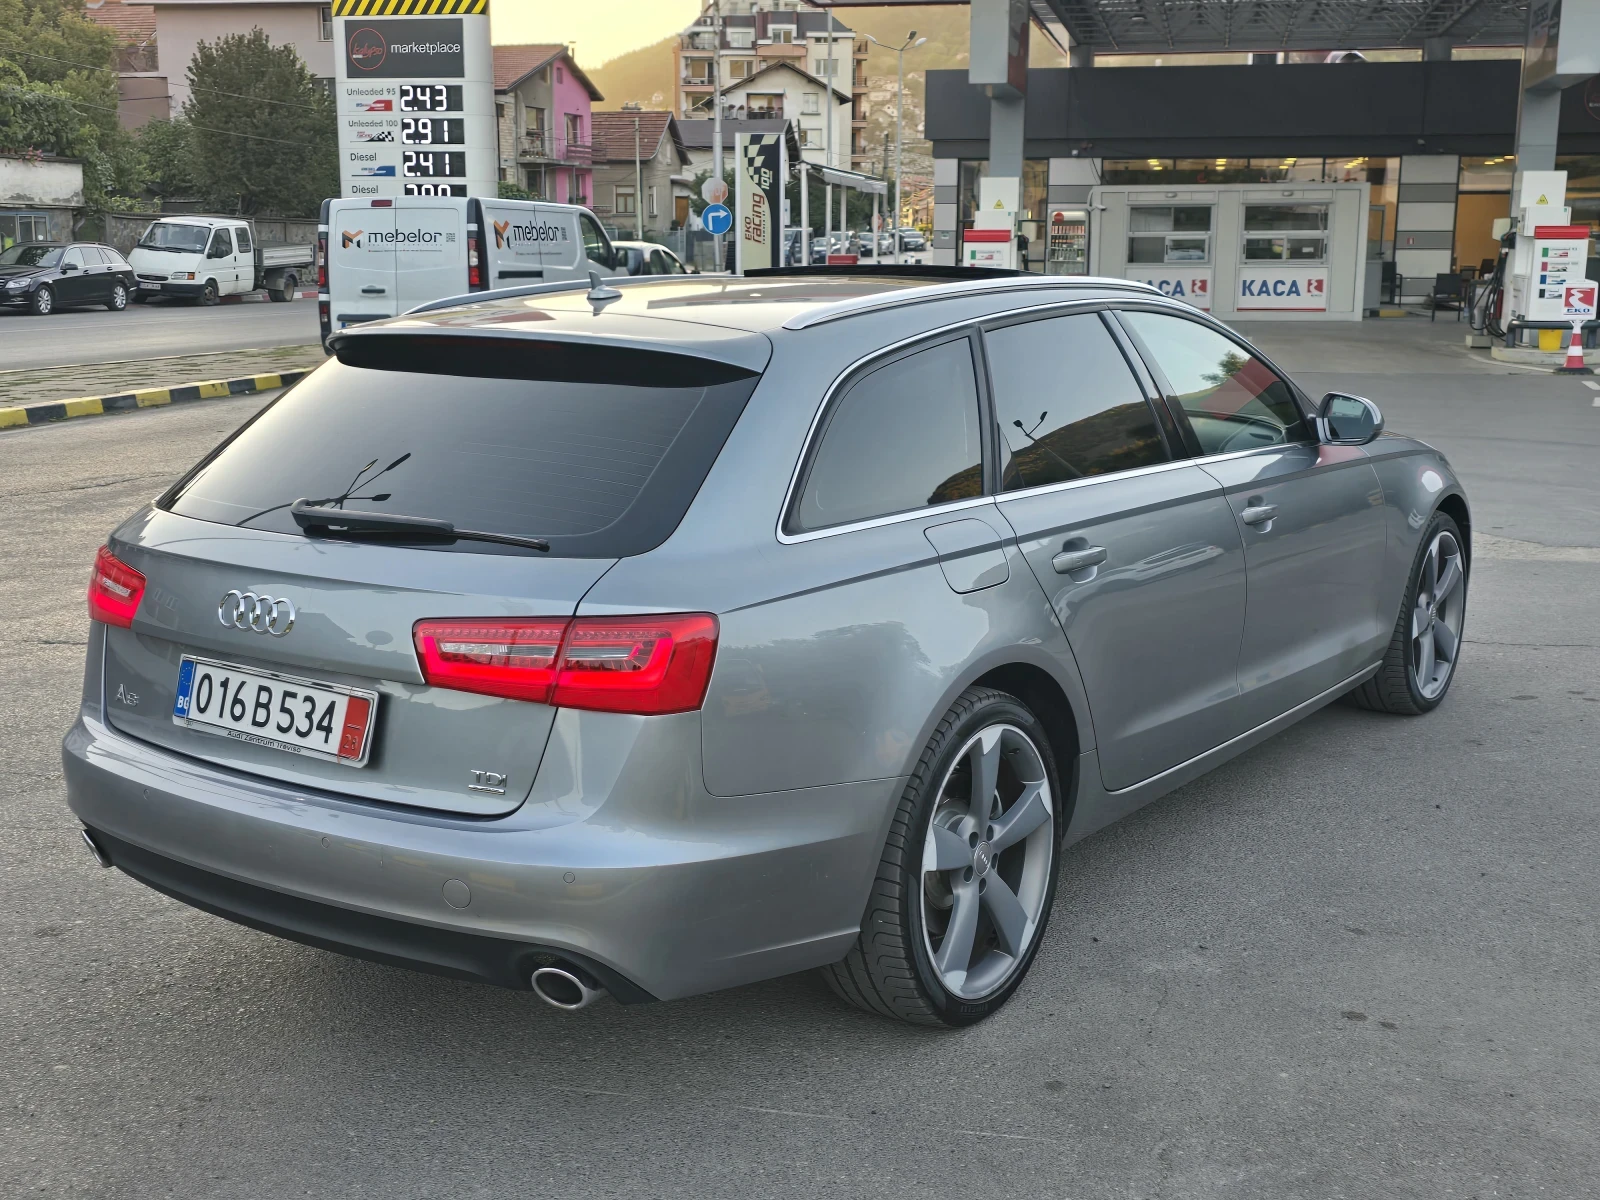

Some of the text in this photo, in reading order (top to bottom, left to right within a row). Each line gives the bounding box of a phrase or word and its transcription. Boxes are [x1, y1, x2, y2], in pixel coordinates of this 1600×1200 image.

[391, 42, 460, 55] marketplace
[346, 88, 396, 96] Unleaded 95
[400, 85, 448, 111] 2.43
[402, 118, 449, 144] 2.91
[350, 152, 377, 162] Diesel
[403, 151, 450, 177] 2.41
[761, 167, 770, 190] 100
[351, 185, 379, 194] Diesel
[752, 192, 766, 244] racing
[368, 229, 442, 243] mebelor
[512, 220, 560, 241] mebelor
[116, 683, 140, 706] A6
[177, 695, 190, 710] BG
[196, 673, 337, 744] 016B534
[226, 731, 302, 753] Audi Zentrum Treviso
[470, 769, 508, 788] TDI
